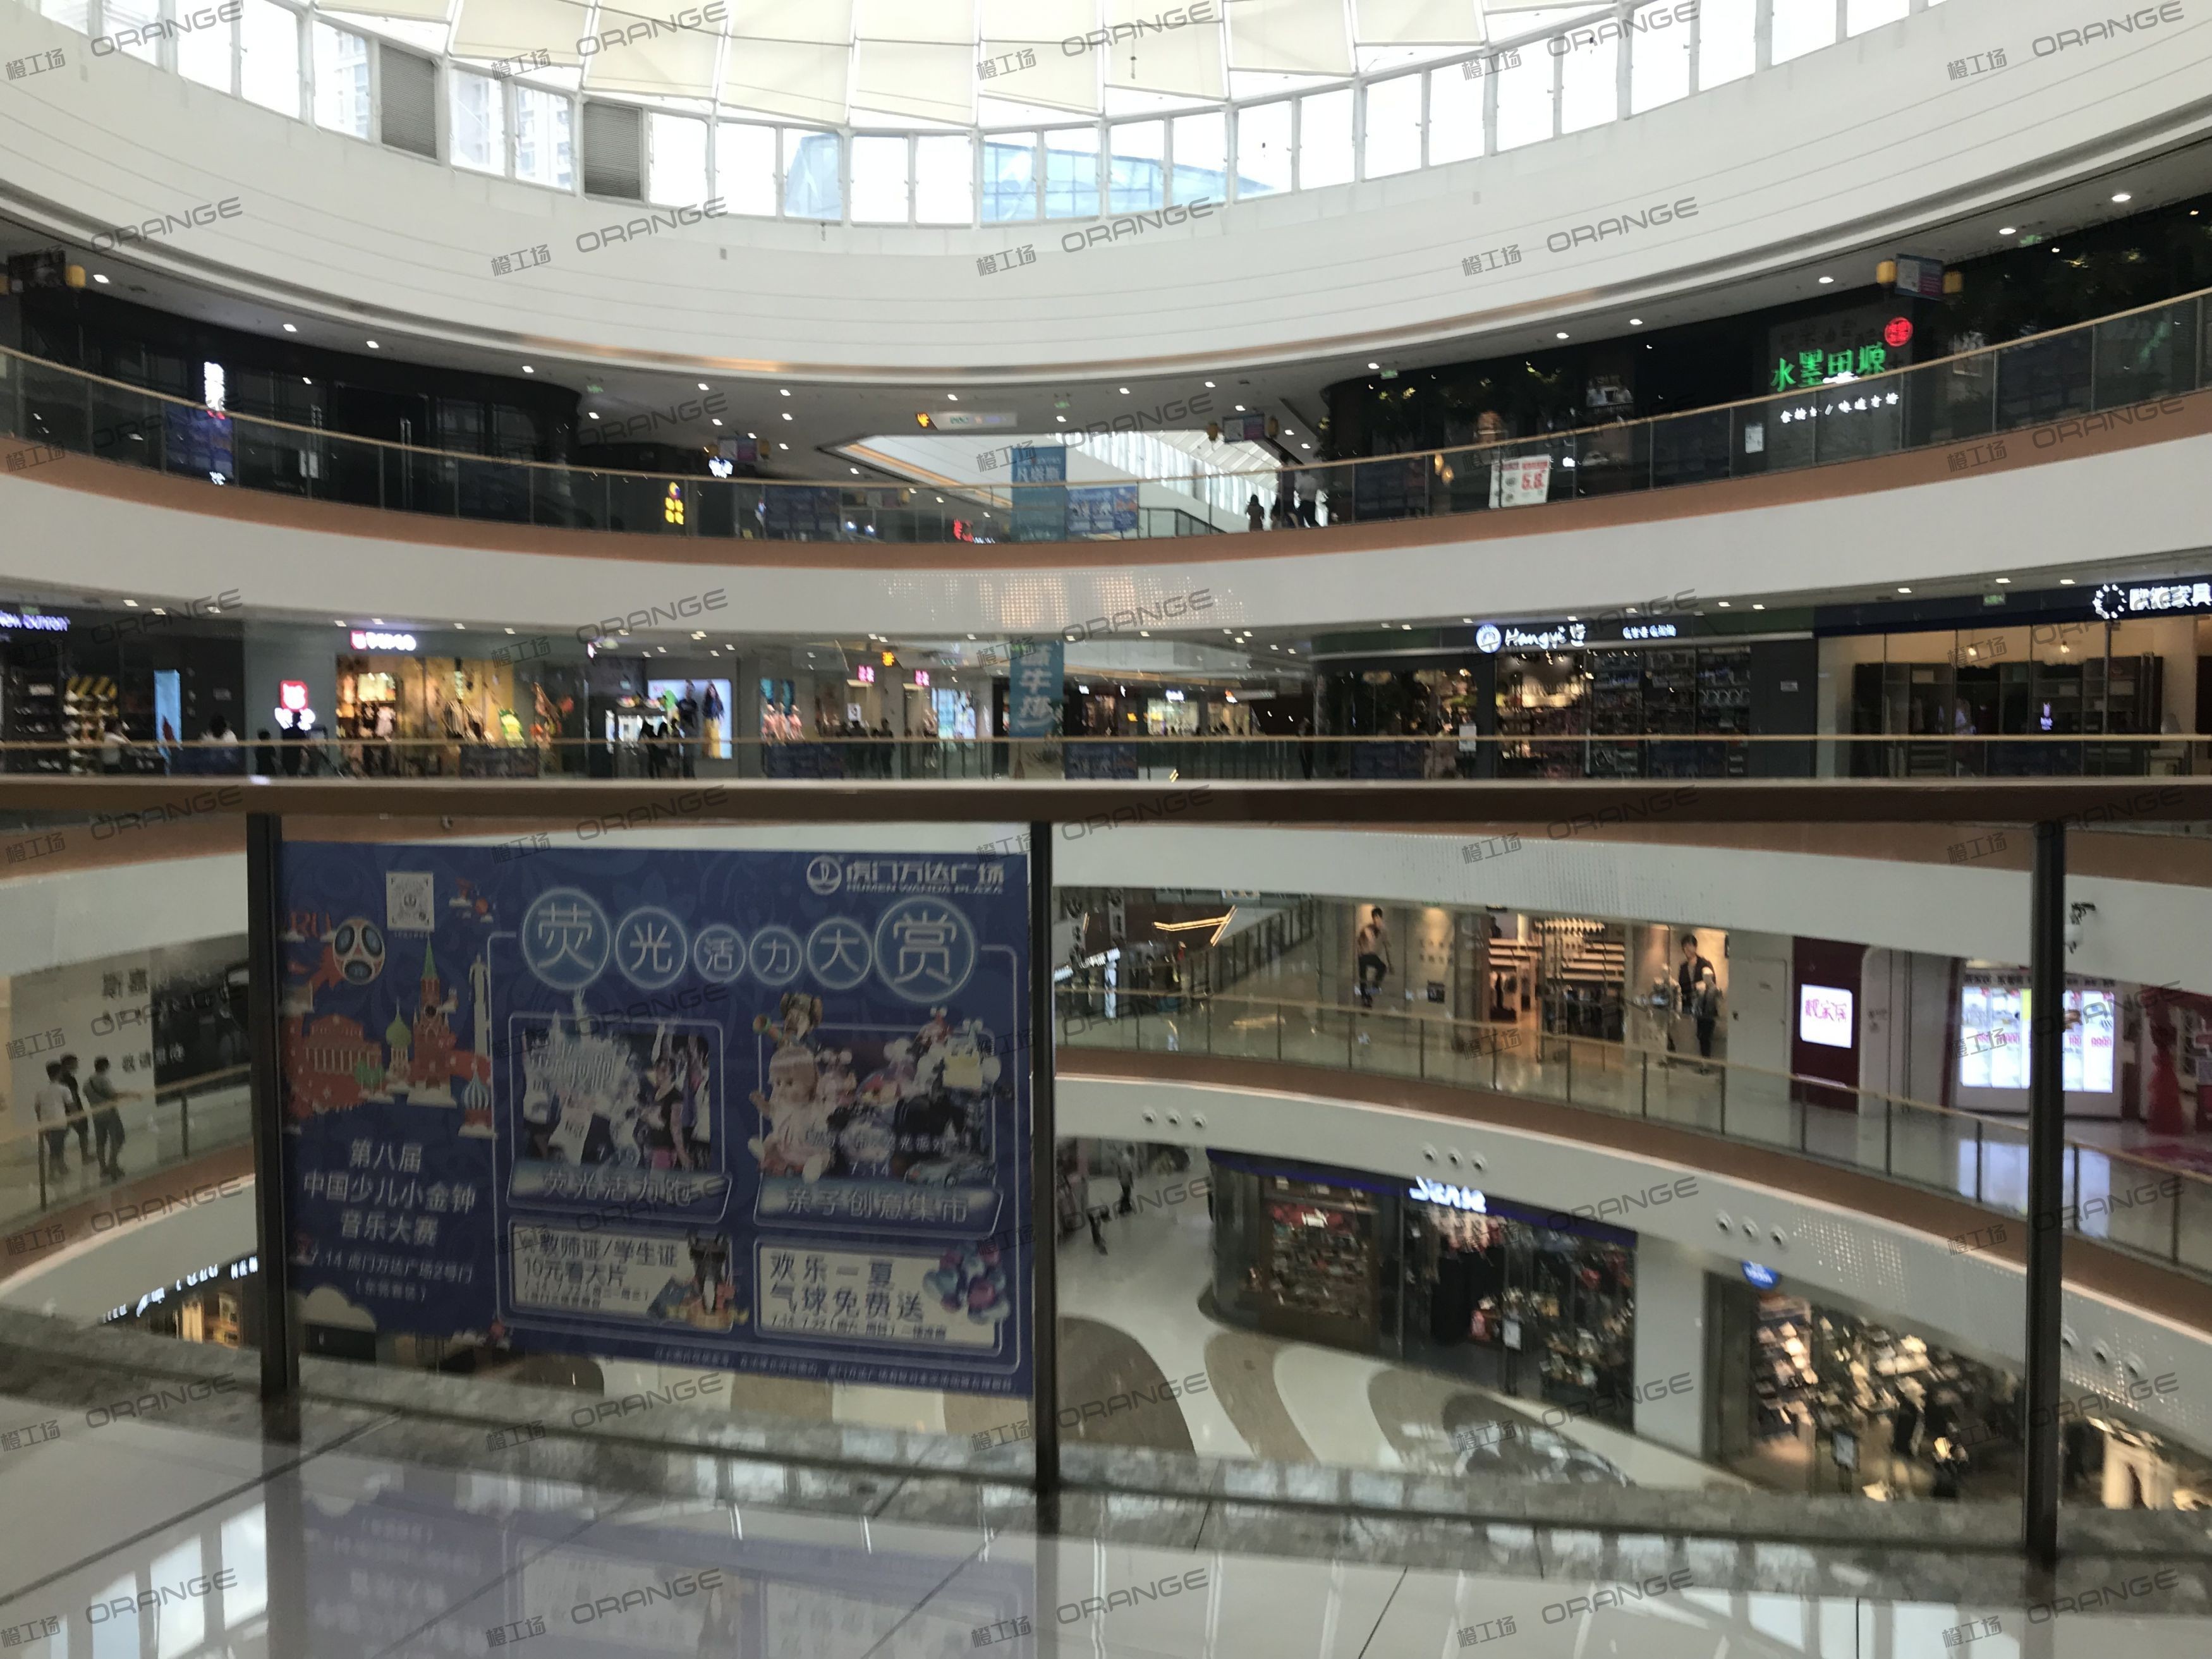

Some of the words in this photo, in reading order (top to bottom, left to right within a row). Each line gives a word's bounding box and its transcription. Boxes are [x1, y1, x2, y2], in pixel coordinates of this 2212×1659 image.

[847, 860, 1005, 885] 虎门万达广场
[537, 903, 957, 985] 荧光活力大赏
[349, 1137, 422, 1174] 第八届
[304, 1169, 476, 1214] 中国少儿小金钟
[341, 1208, 439, 1247] 音乐大赛
[769, 1251, 894, 1291] 欢乐一夏
[770, 1282, 924, 1322] 气球免费送
